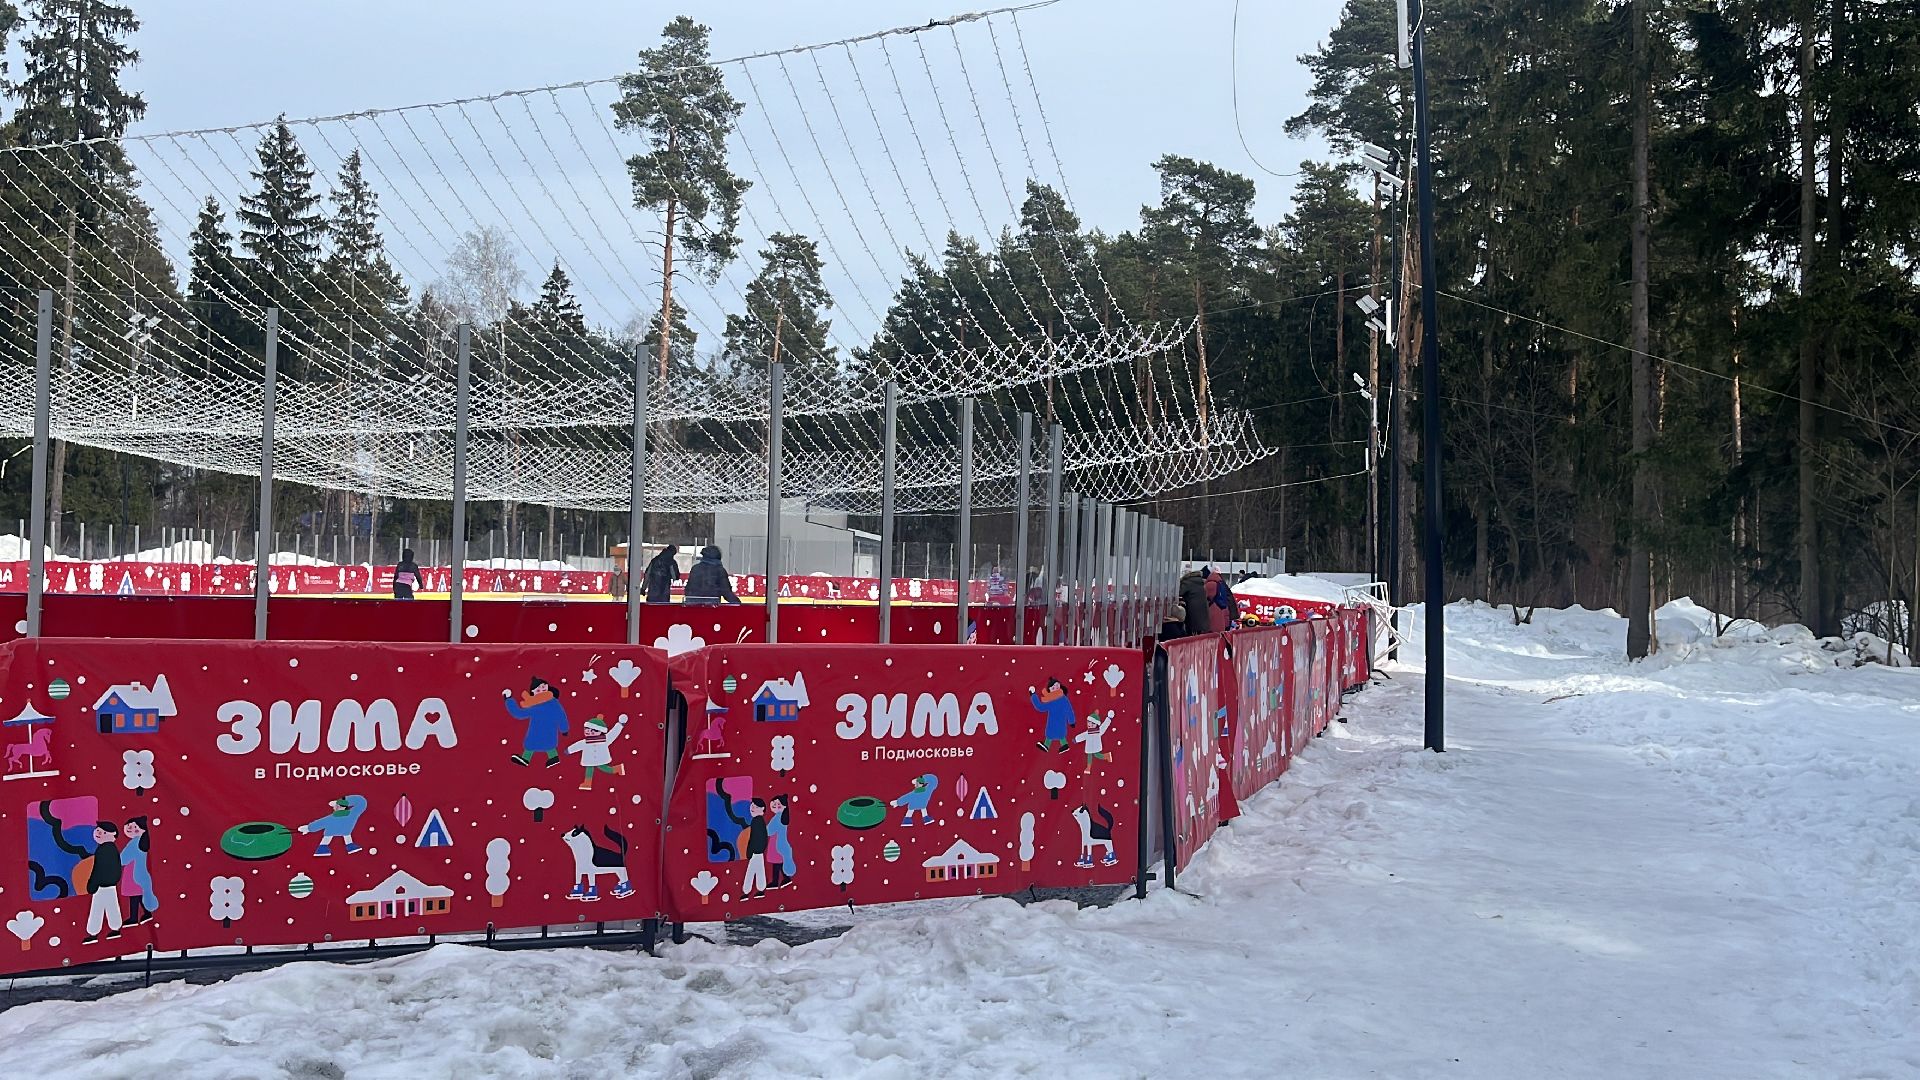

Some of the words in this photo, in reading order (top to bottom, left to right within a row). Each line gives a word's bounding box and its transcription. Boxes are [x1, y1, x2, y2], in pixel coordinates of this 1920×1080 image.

[216, 697, 458, 755] ЗИМА
[835, 691, 999, 740] ЗИМА
[861, 750, 869, 761] в
[875, 745, 974, 761] Подмосковье
[254, 767, 266, 779] в
[275, 763, 421, 781] Подмосковье
